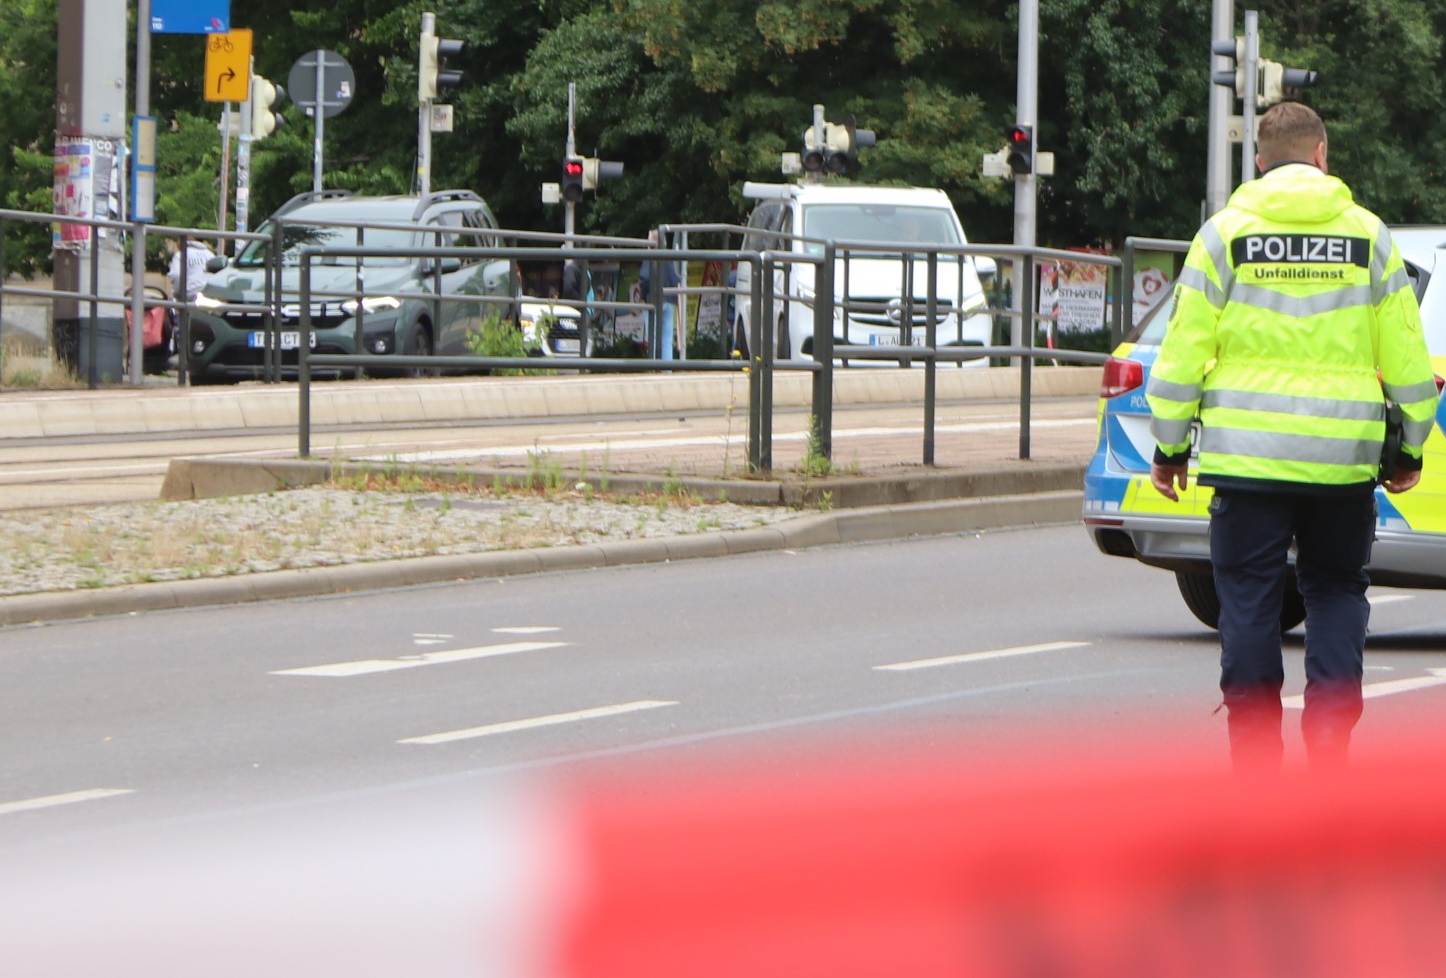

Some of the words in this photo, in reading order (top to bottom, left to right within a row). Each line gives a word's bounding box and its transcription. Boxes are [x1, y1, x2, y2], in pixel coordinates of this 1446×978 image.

[1246, 236, 1352, 263] POLIZEI
[1254, 267, 1345, 280] Unfalldienst
[1043, 286, 1102, 299] WSTHAFEN
